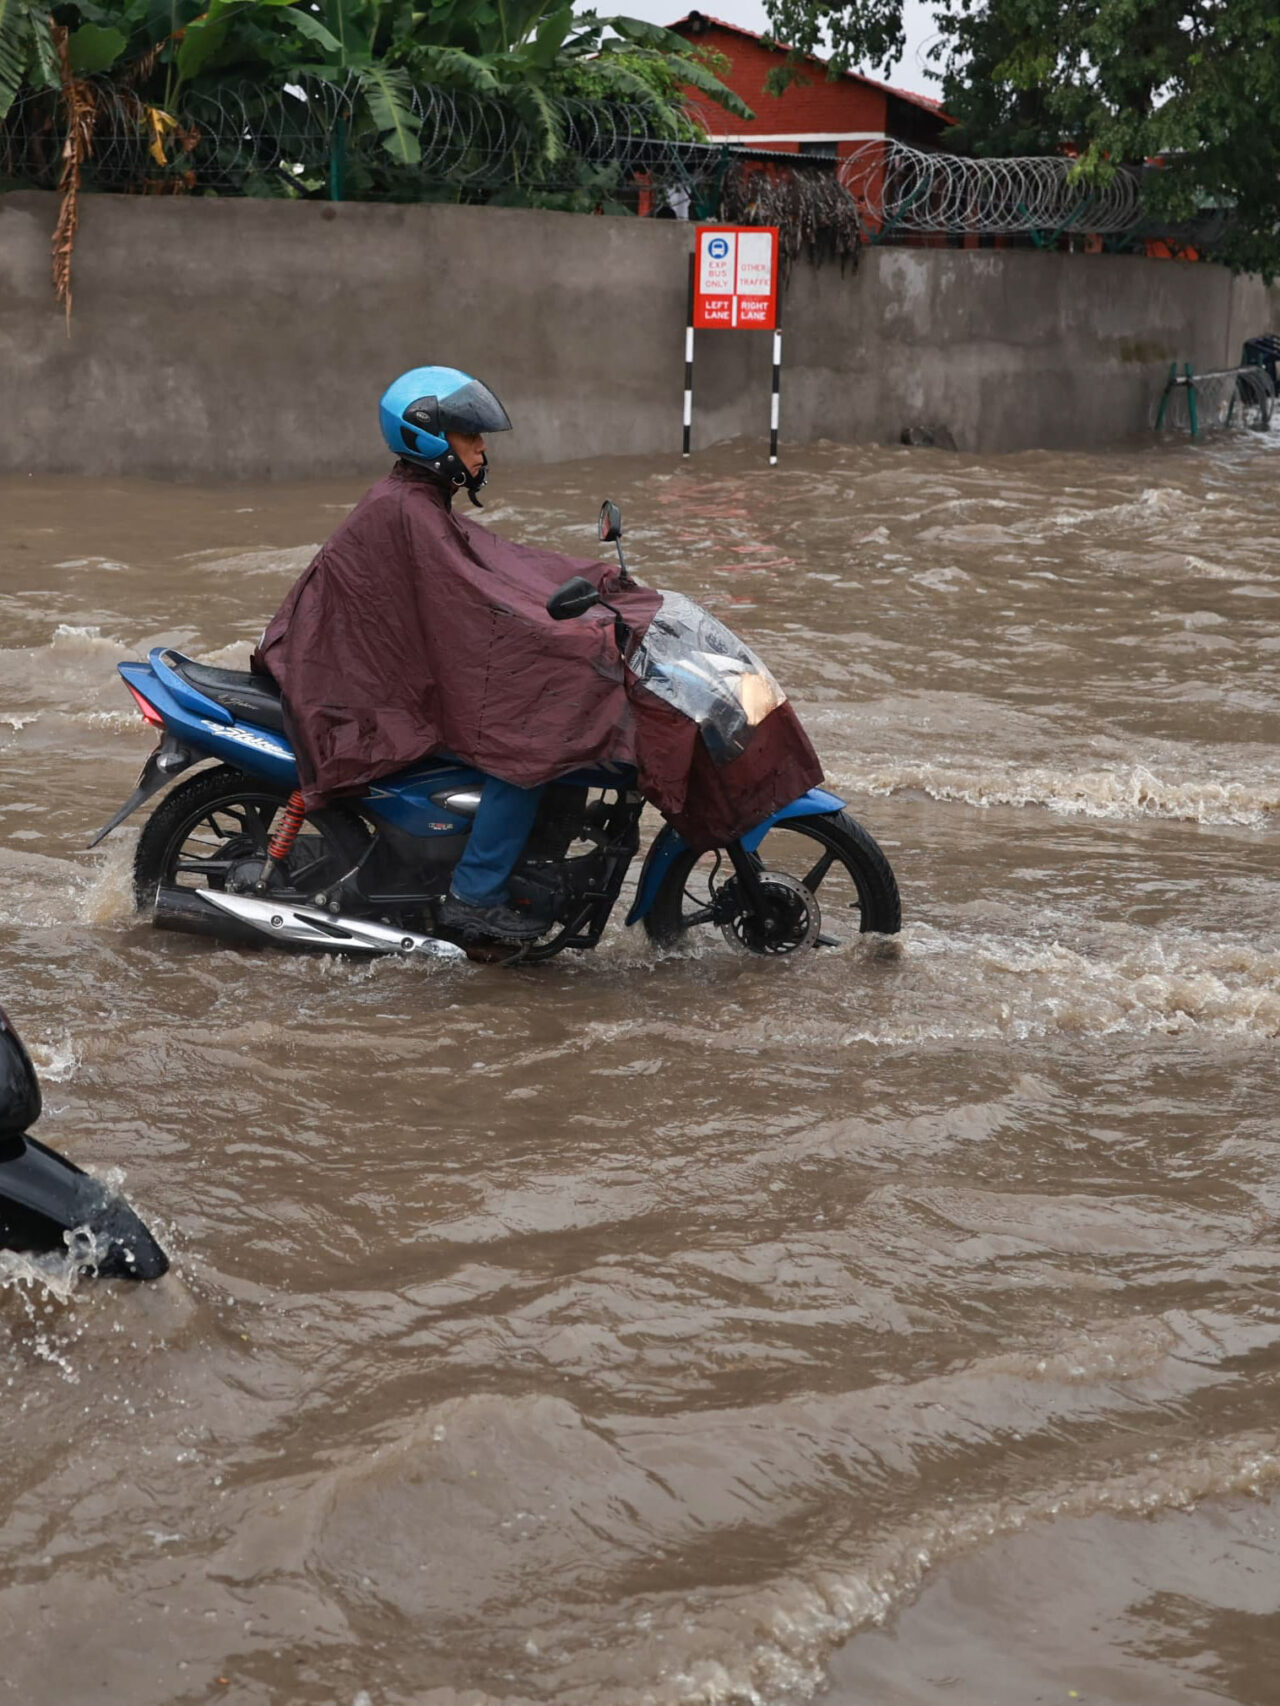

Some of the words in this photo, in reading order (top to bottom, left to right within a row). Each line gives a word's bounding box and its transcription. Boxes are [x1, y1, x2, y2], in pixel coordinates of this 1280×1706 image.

[708, 261, 727, 269] EXP
[741, 264, 766, 272] OTHER
[708, 270, 727, 278] BUS
[705, 280, 728, 288] ONLY
[705, 301, 729, 310] LEFT
[741, 302, 768, 311] RIGHT
[705, 311, 729, 320] LANE
[740, 311, 766, 321] LANE
